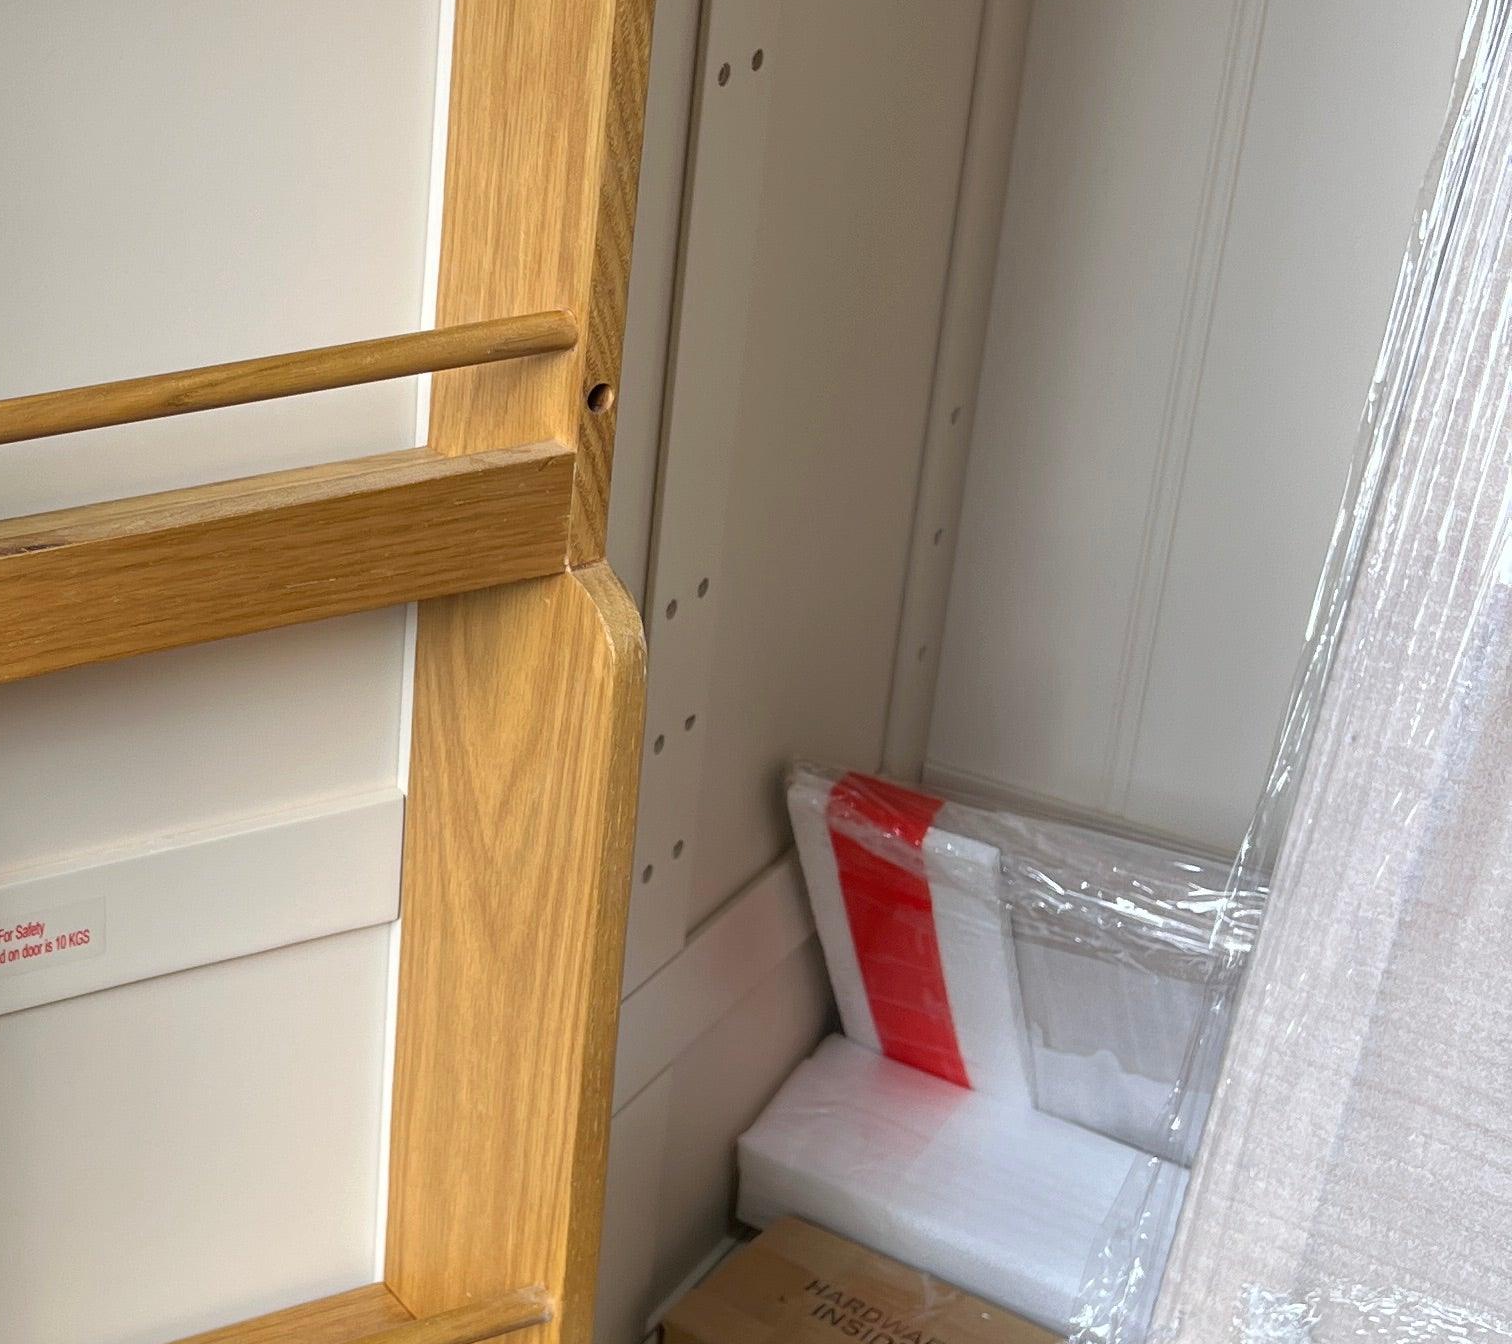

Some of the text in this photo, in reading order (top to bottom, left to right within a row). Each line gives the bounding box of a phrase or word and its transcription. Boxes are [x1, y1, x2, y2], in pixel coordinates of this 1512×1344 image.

[16, 922, 46, 940] Safety
[7, 949, 21, 962] on
[22, 941, 43, 958] door
[44, 941, 54, 953] is
[55, 935, 67, 950] 10
[68, 928, 90, 948] KGS
